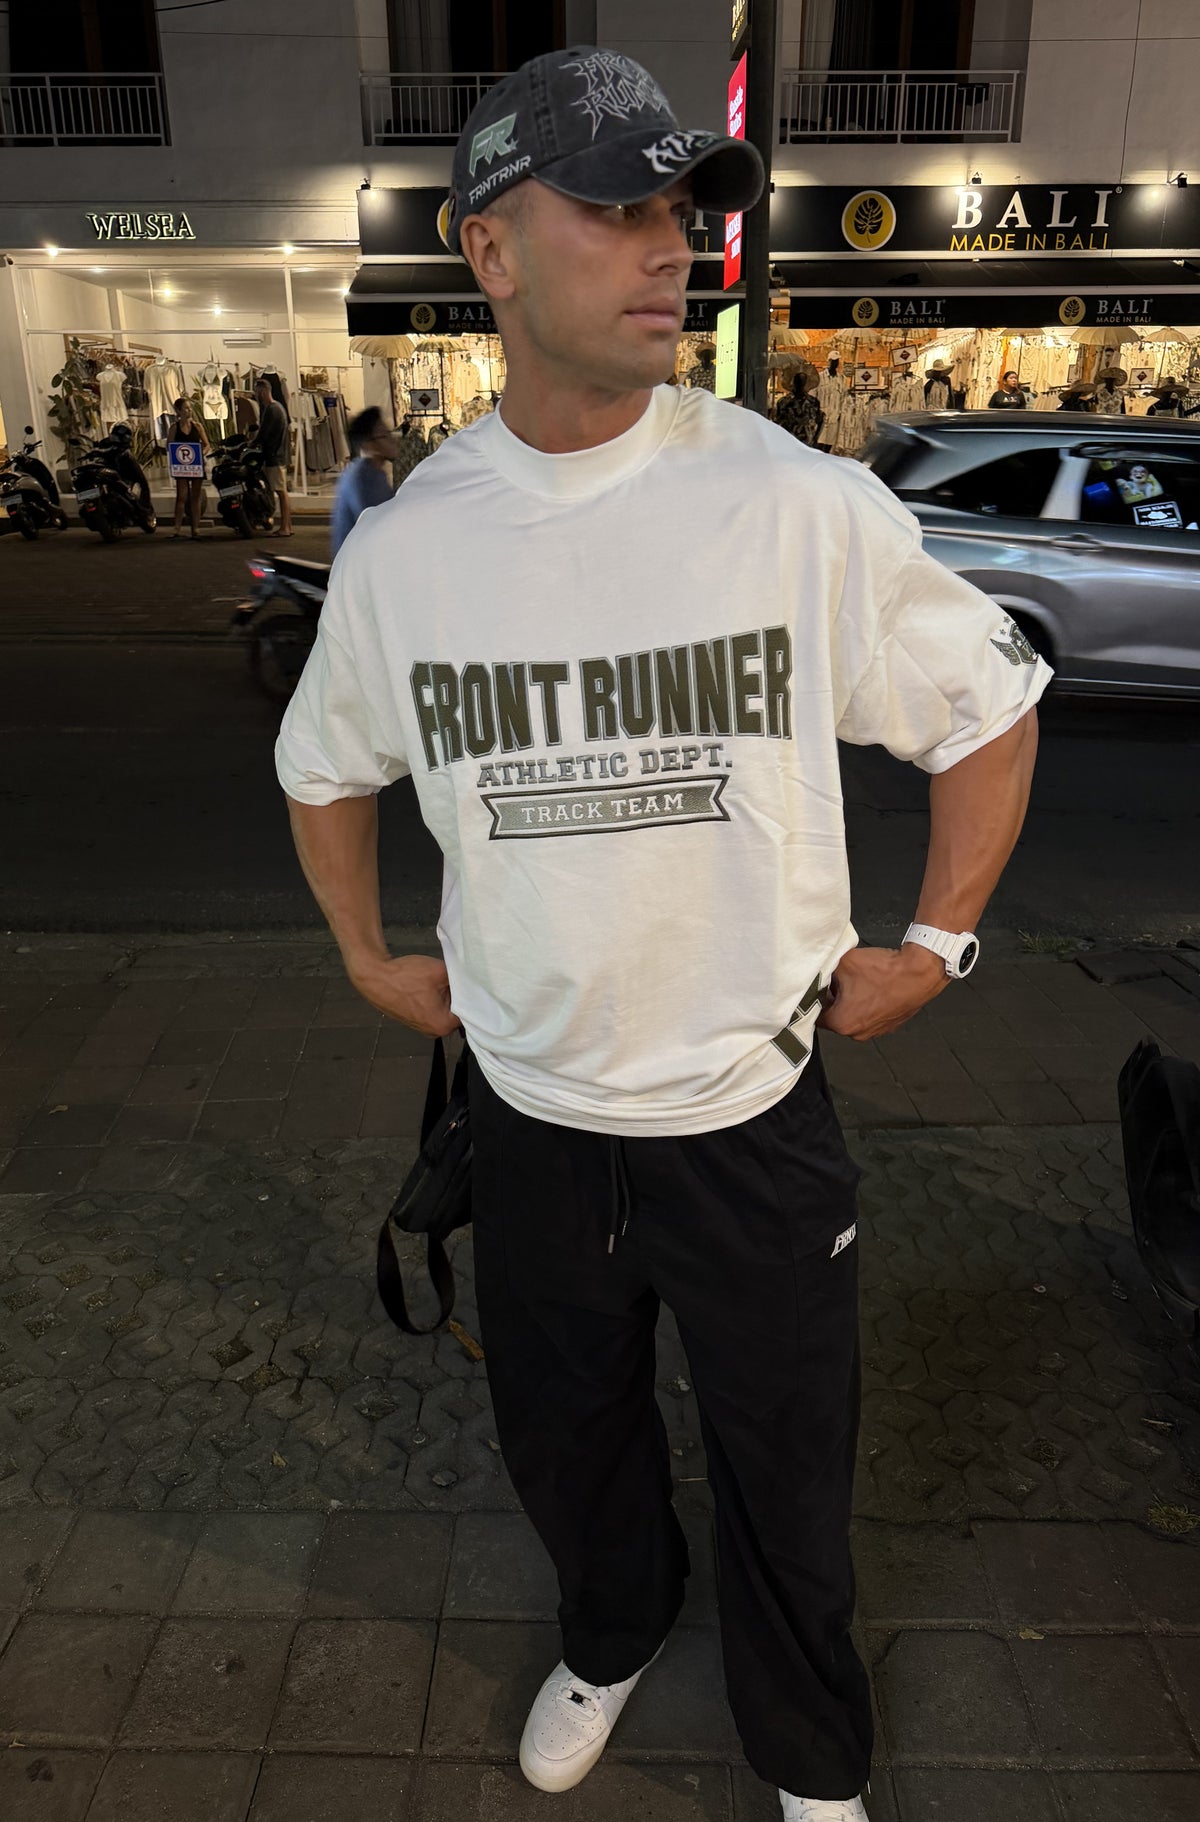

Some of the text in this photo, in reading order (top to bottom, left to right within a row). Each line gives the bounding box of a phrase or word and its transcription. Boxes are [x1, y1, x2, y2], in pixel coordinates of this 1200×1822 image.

[468, 155, 531, 205] FRNTRNR
[951, 190, 1113, 229] BALI
[85, 212, 197, 239] WELSEA
[950, 233, 1109, 251] MADE IN BALI
[448, 306, 491, 320] BAL
[890, 300, 943, 316] BALI
[1097, 299, 1151, 314] BALI
[890, 317, 914, 325] MADE
[928, 316, 946, 324] BALI
[1134, 315, 1152, 323] BALI
[409, 623, 793, 772] FRONT RUNNER
[477, 742, 733, 788] ATHLETIC DEPT.
[521, 792, 685, 824] TRACK TEAM
